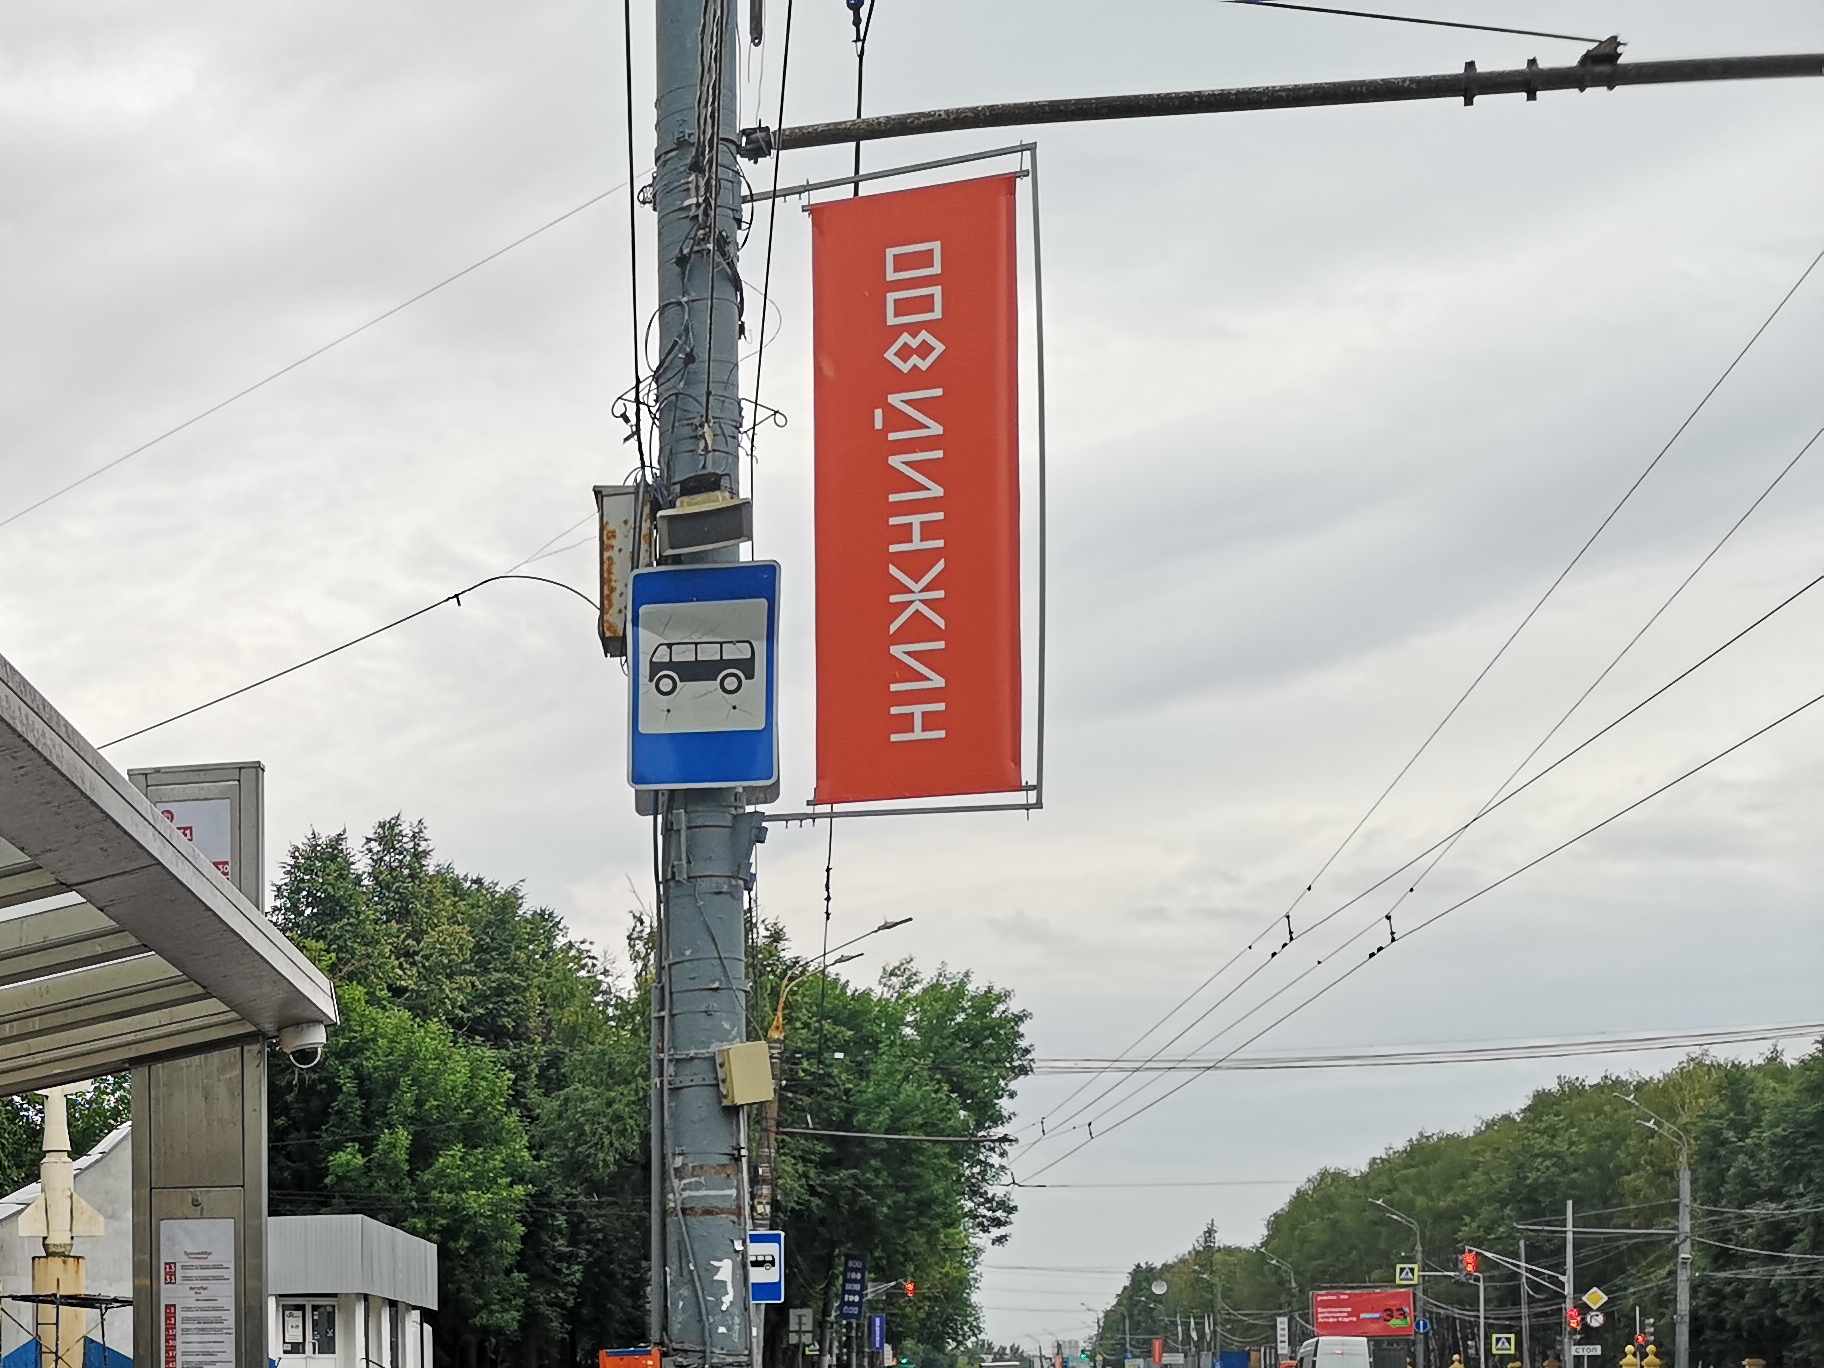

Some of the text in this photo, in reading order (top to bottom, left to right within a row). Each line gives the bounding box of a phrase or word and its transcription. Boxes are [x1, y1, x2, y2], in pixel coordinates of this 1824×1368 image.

[874, 239, 946, 743] НИЖНИЙ 800
[165, 1263, 175, 1272] 13
[165, 1274, 176, 1283] 31
[1574, 1346, 1598, 1354] СТОП
